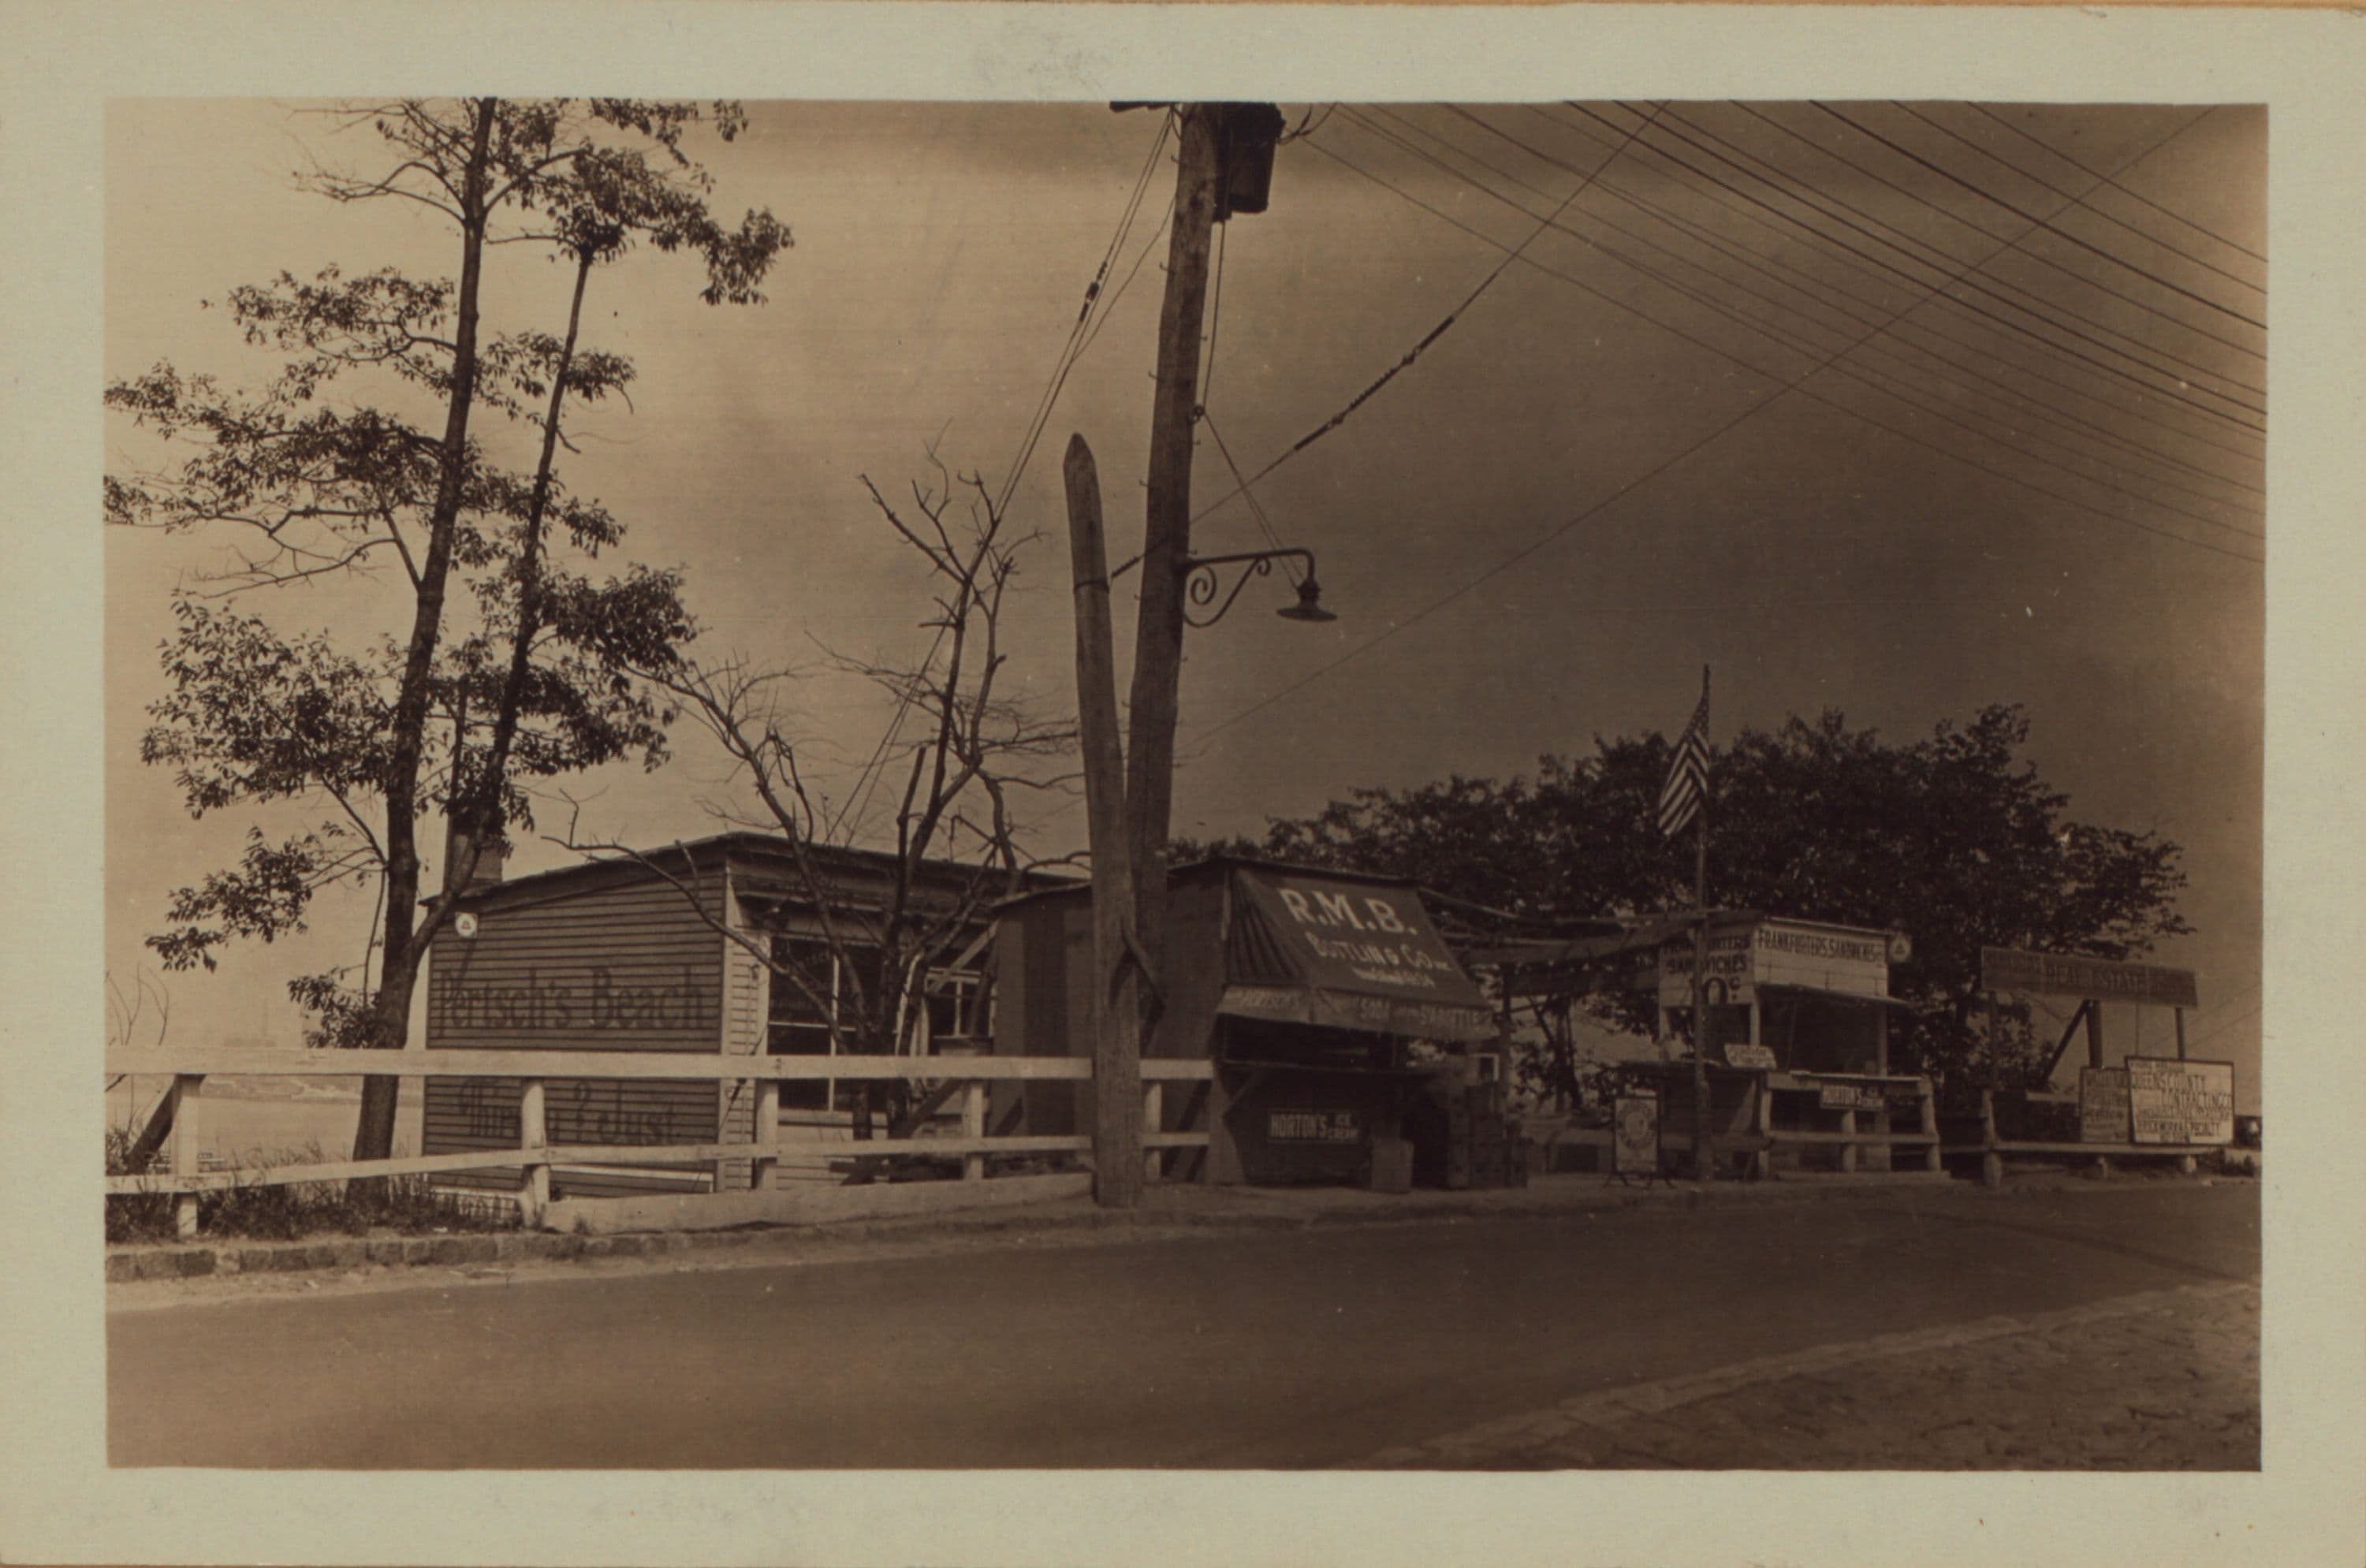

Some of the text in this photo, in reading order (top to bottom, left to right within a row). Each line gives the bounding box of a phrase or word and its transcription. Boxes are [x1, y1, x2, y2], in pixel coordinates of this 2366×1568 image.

[1277, 888, 1418, 937] R.M.B.
[589, 965, 703, 1030] Beach
[1270, 1113, 1327, 1138] HORTON'S
